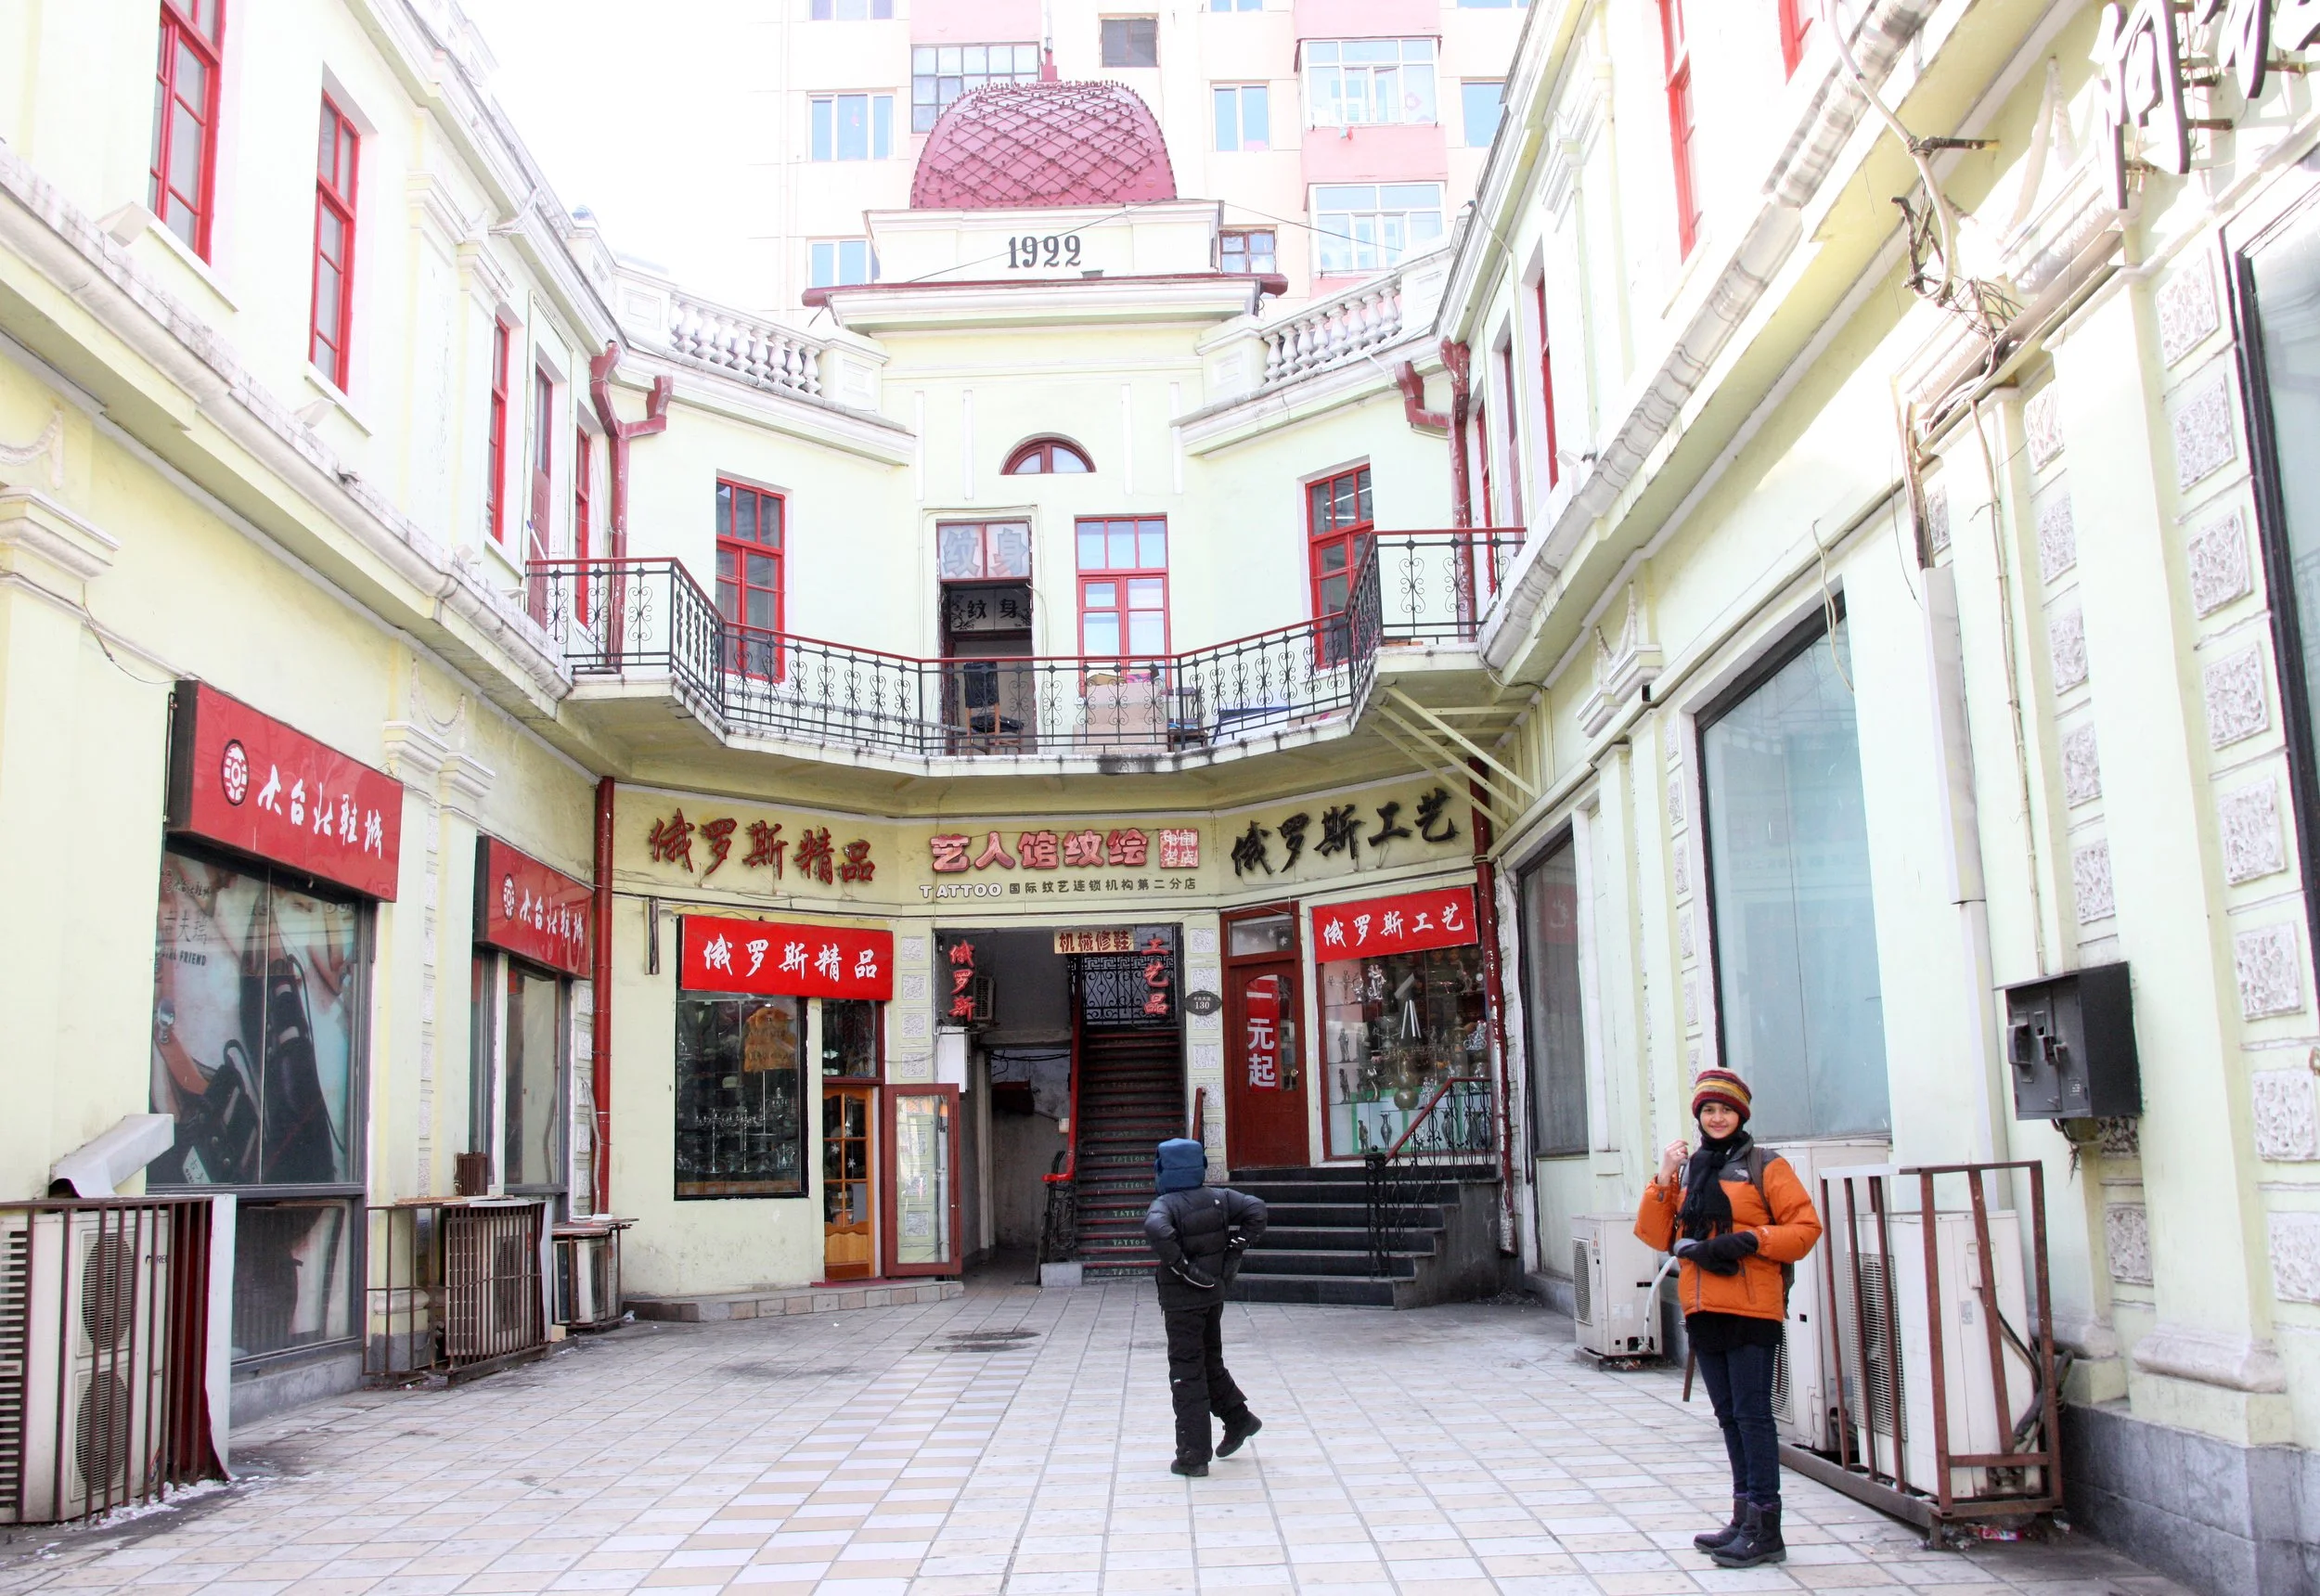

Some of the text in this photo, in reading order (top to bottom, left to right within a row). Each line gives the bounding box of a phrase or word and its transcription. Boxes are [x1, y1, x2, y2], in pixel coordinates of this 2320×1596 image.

[1008, 235, 1081, 269] 1922
[943, 527, 1027, 576] 纹身
[967, 598, 1018, 620] 纹身
[649, 807, 876, 884] 俄罗斯精品
[929, 827, 1149, 872] 艺人馆纹绘
[1231, 788, 1461, 877] 俄罗斯工艺
[920, 882, 1003, 899] TATTOO
[1009, 877, 1197, 895] 国际纹艺连锁机构第二分店
[1059, 930, 1131, 953] 机械修鞋
[1322, 902, 1464, 948] 俄罗斯工艺
[179, 950, 207, 966] FRIEND
[703, 933, 878, 982] 俄罗斯精品
[948, 939, 975, 1021] 俄罗斯
[1141, 938, 1169, 1016] 工艺品
[1195, 1001, 1210, 1010] 130
[1246, 991, 1276, 1088] 一元起
